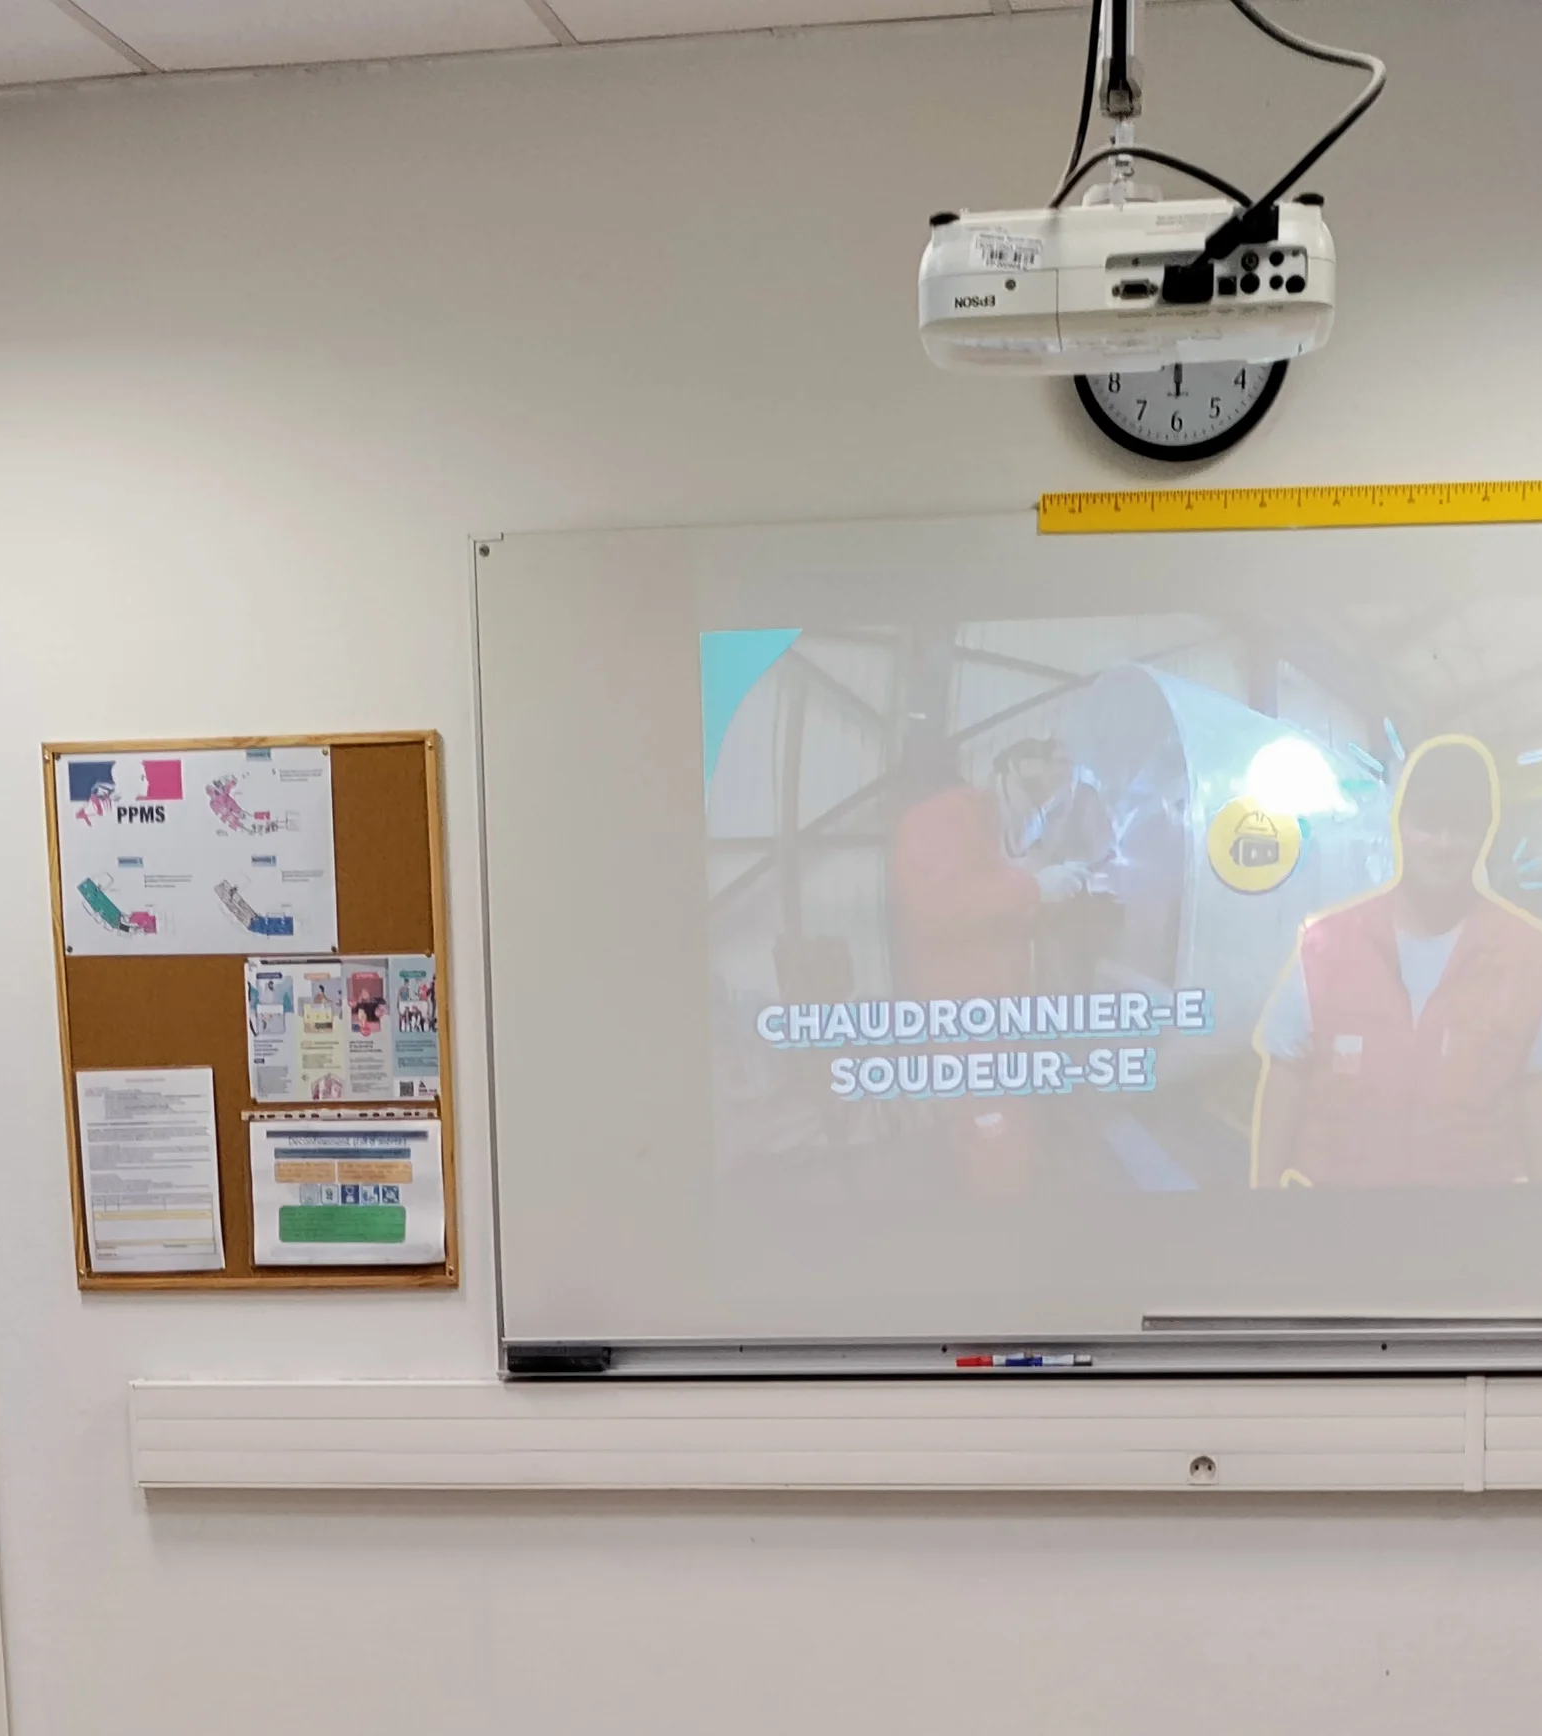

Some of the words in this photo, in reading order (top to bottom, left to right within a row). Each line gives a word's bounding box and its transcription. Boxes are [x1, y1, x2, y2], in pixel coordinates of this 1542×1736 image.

[954, 294, 996, 309] EPSON
[1108, 371, 1121, 394] 8
[1233, 367, 1247, 391] 4
[1136, 399, 1148, 421] 7
[1208, 397, 1221, 419] 5
[1170, 410, 1184, 433] 6
[117, 805, 166, 824] PPMS
[756, 989, 1213, 1046] CHAUDRONNIER-E
[829, 1046, 1155, 1099] SOUDEUR-SE
